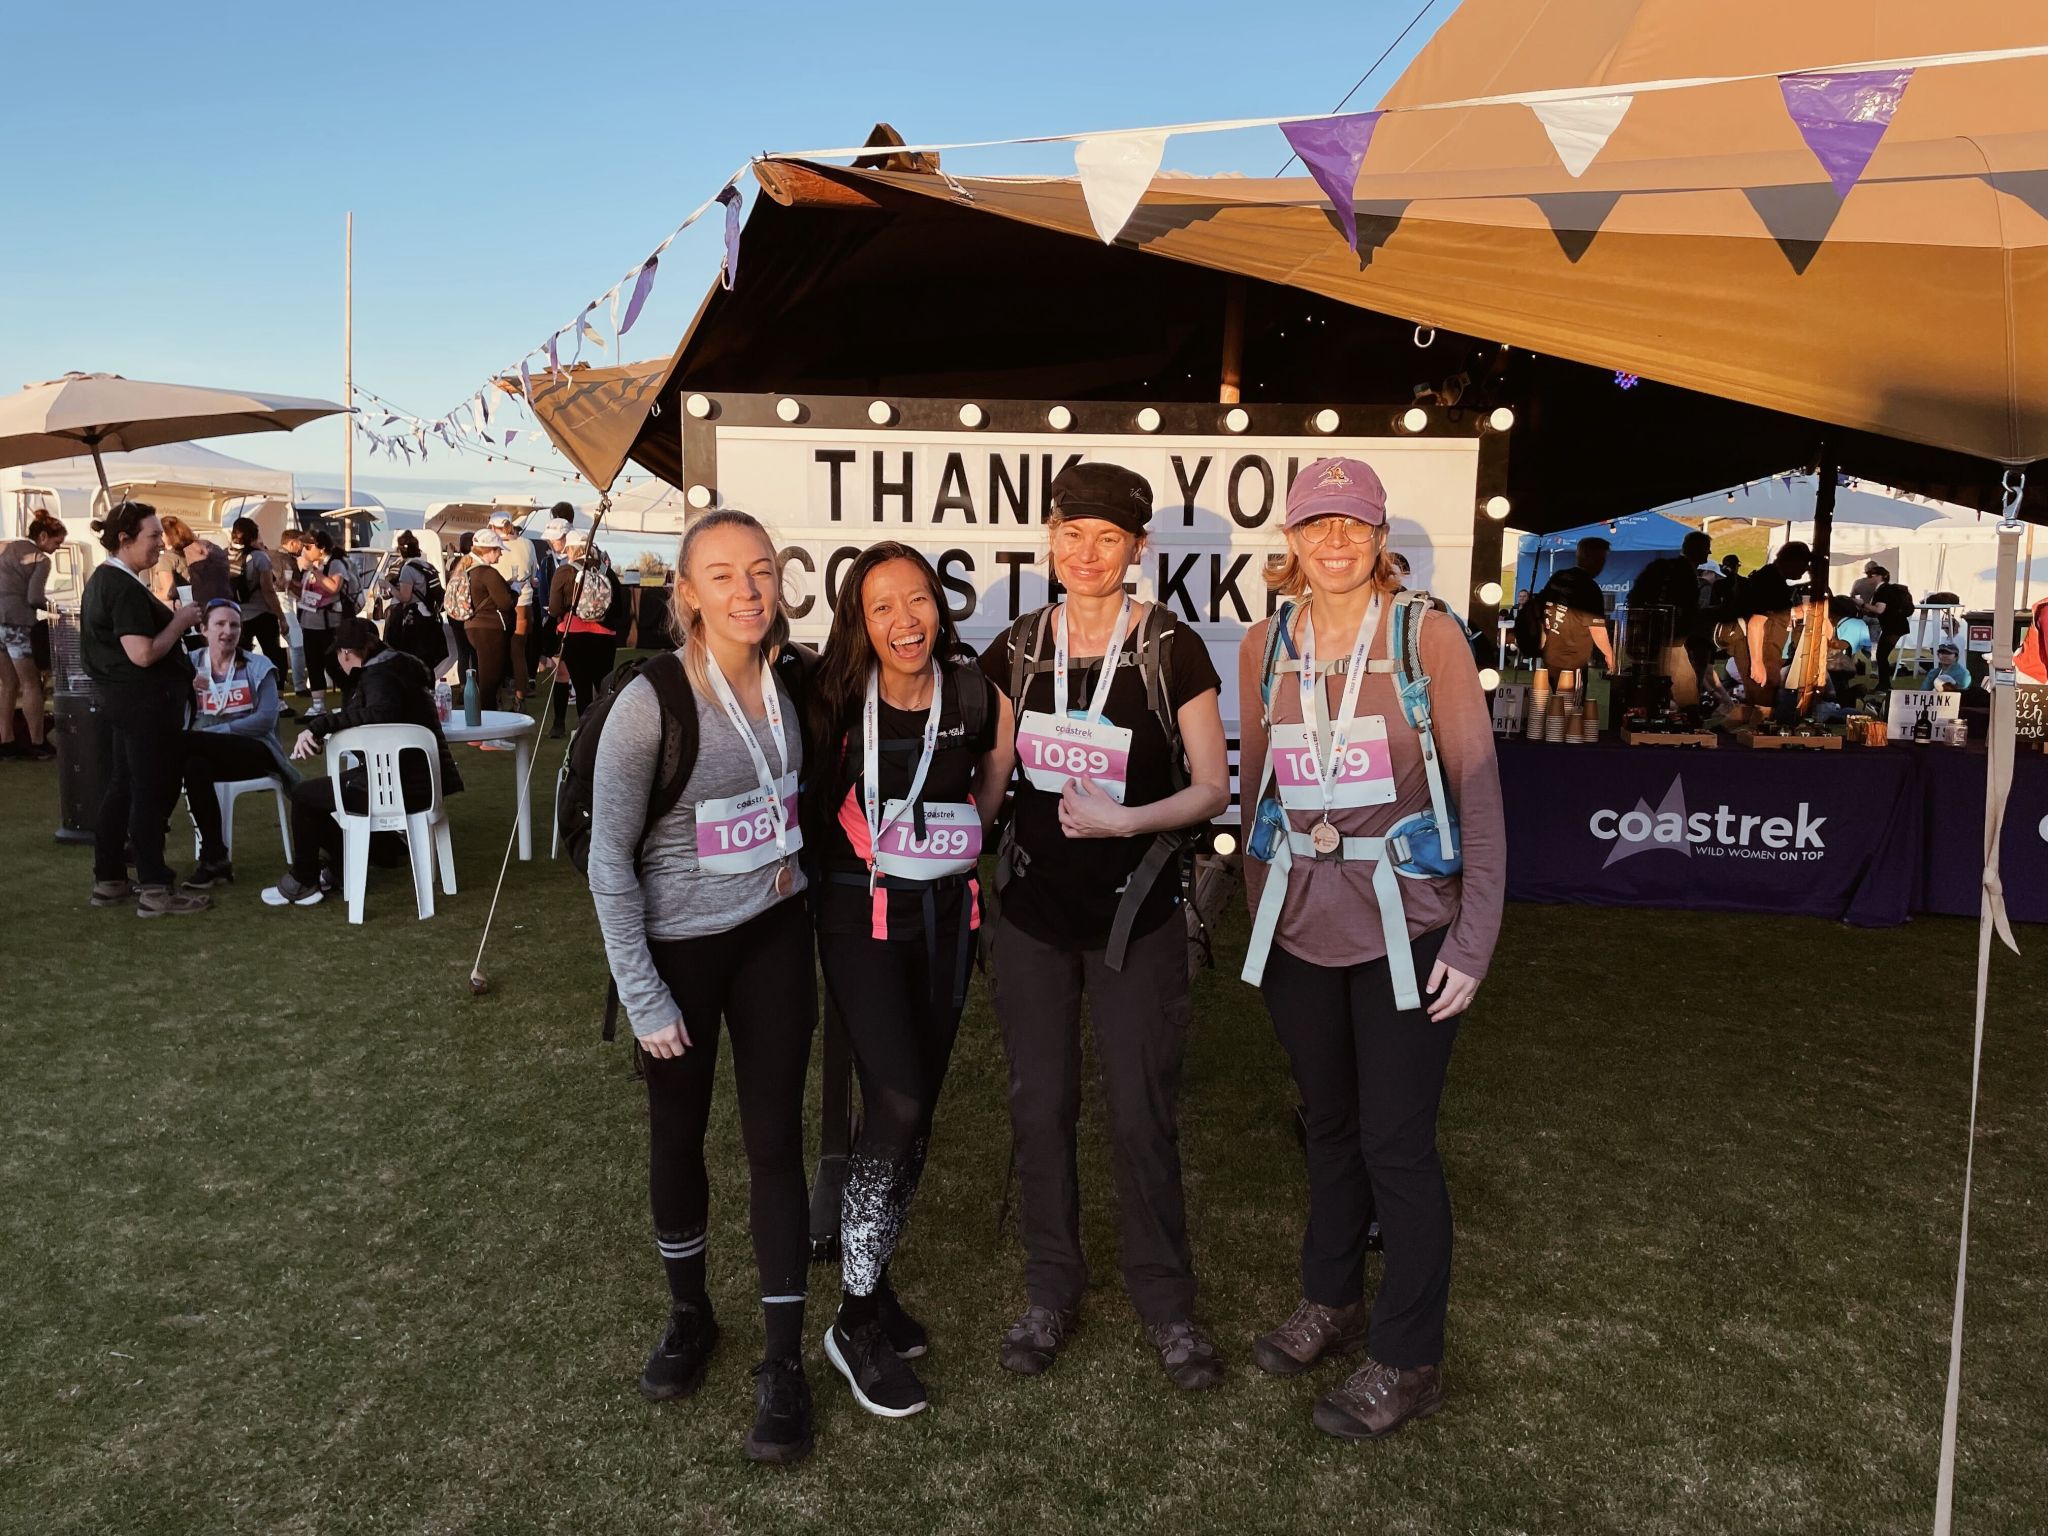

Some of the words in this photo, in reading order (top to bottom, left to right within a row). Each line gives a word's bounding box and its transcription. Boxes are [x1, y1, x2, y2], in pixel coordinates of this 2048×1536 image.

[815, 450, 1084, 524] THANK
[1170, 454, 1327, 528] YO
[1905, 694, 1951, 707] #THANK
[1916, 710, 1937, 722] YU
[1055, 724, 1093, 738] coastrek
[1031, 740, 1109, 774] 1089
[1286, 748, 1370, 780] 109
[736, 796, 764, 809] coastr
[1590, 802, 1827, 848] coastrek
[896, 826, 969, 855] 1089
[1695, 846, 1724, 857] WILD
[1728, 848, 1776, 860] WOMEN
[1779, 851, 1798, 861] ON
[1801, 851, 1824, 861] TOP
